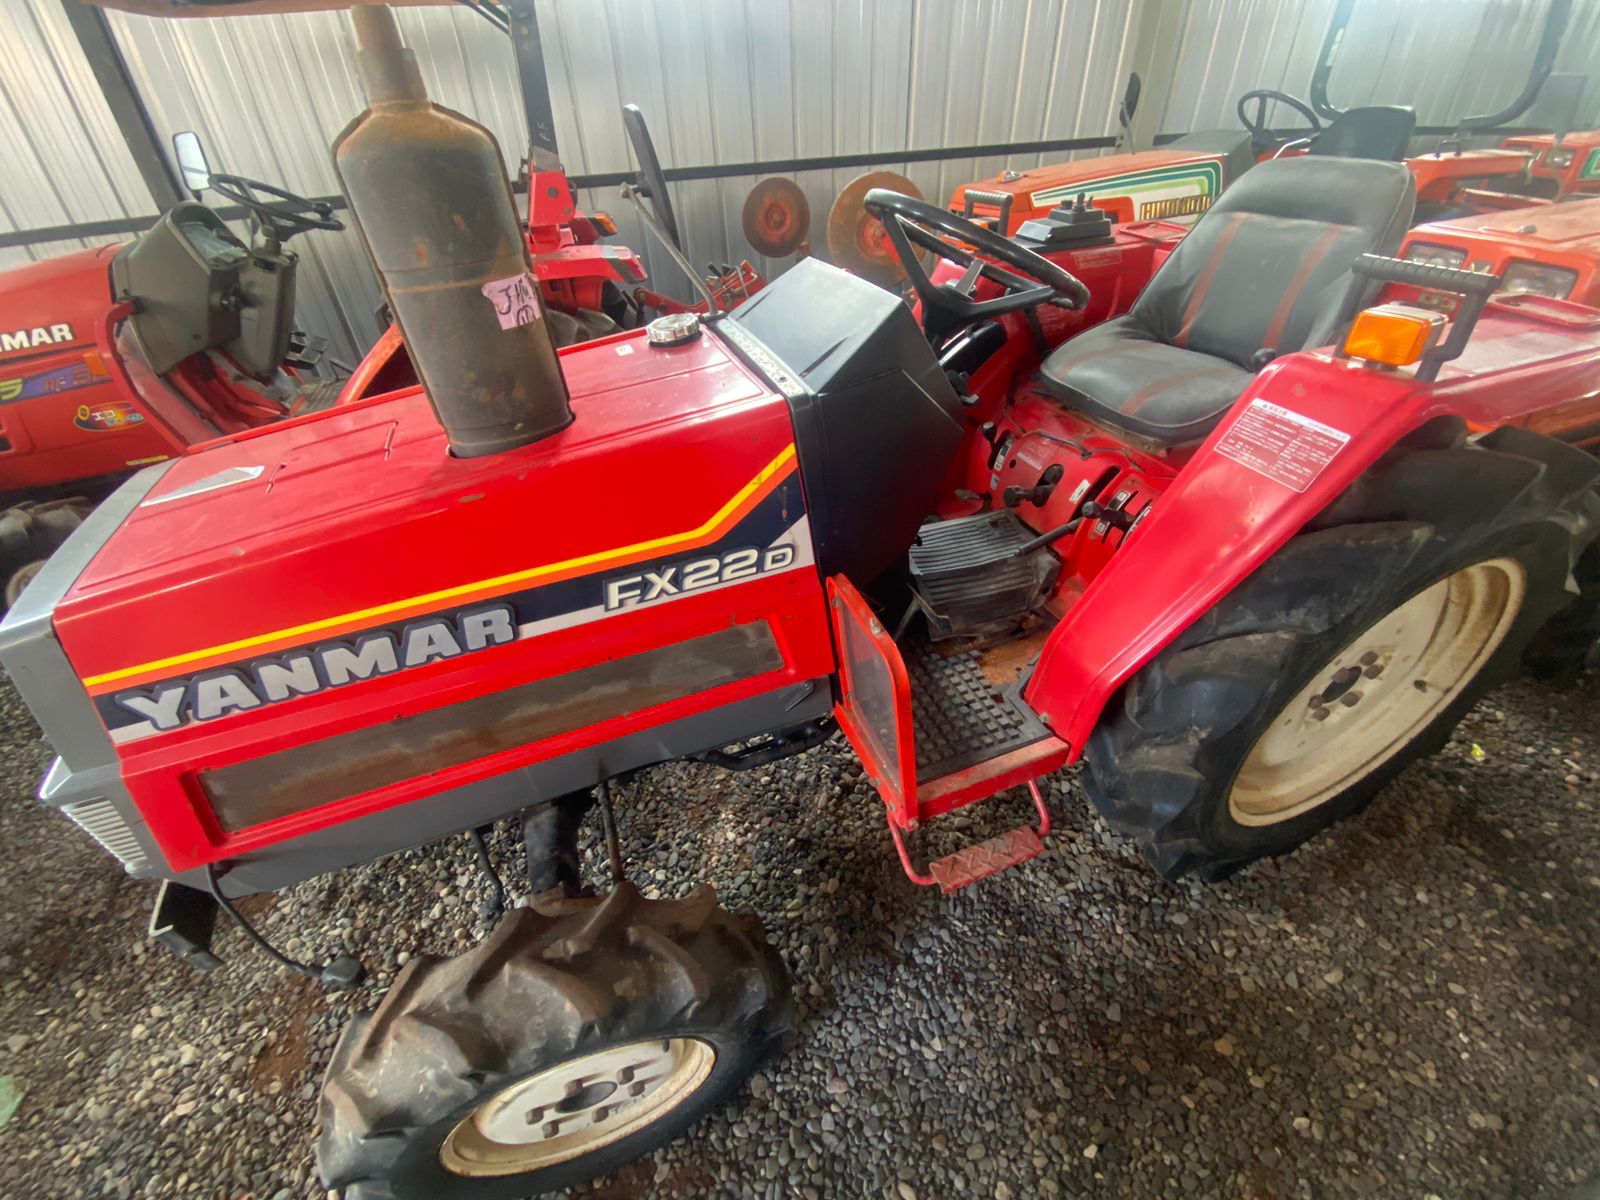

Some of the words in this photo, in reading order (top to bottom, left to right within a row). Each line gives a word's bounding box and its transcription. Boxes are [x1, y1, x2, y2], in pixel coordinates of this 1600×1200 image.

[0, 323, 74, 352] MAR
[597, 546, 793, 610] FX22D
[120, 607, 516, 730] YANMAR
